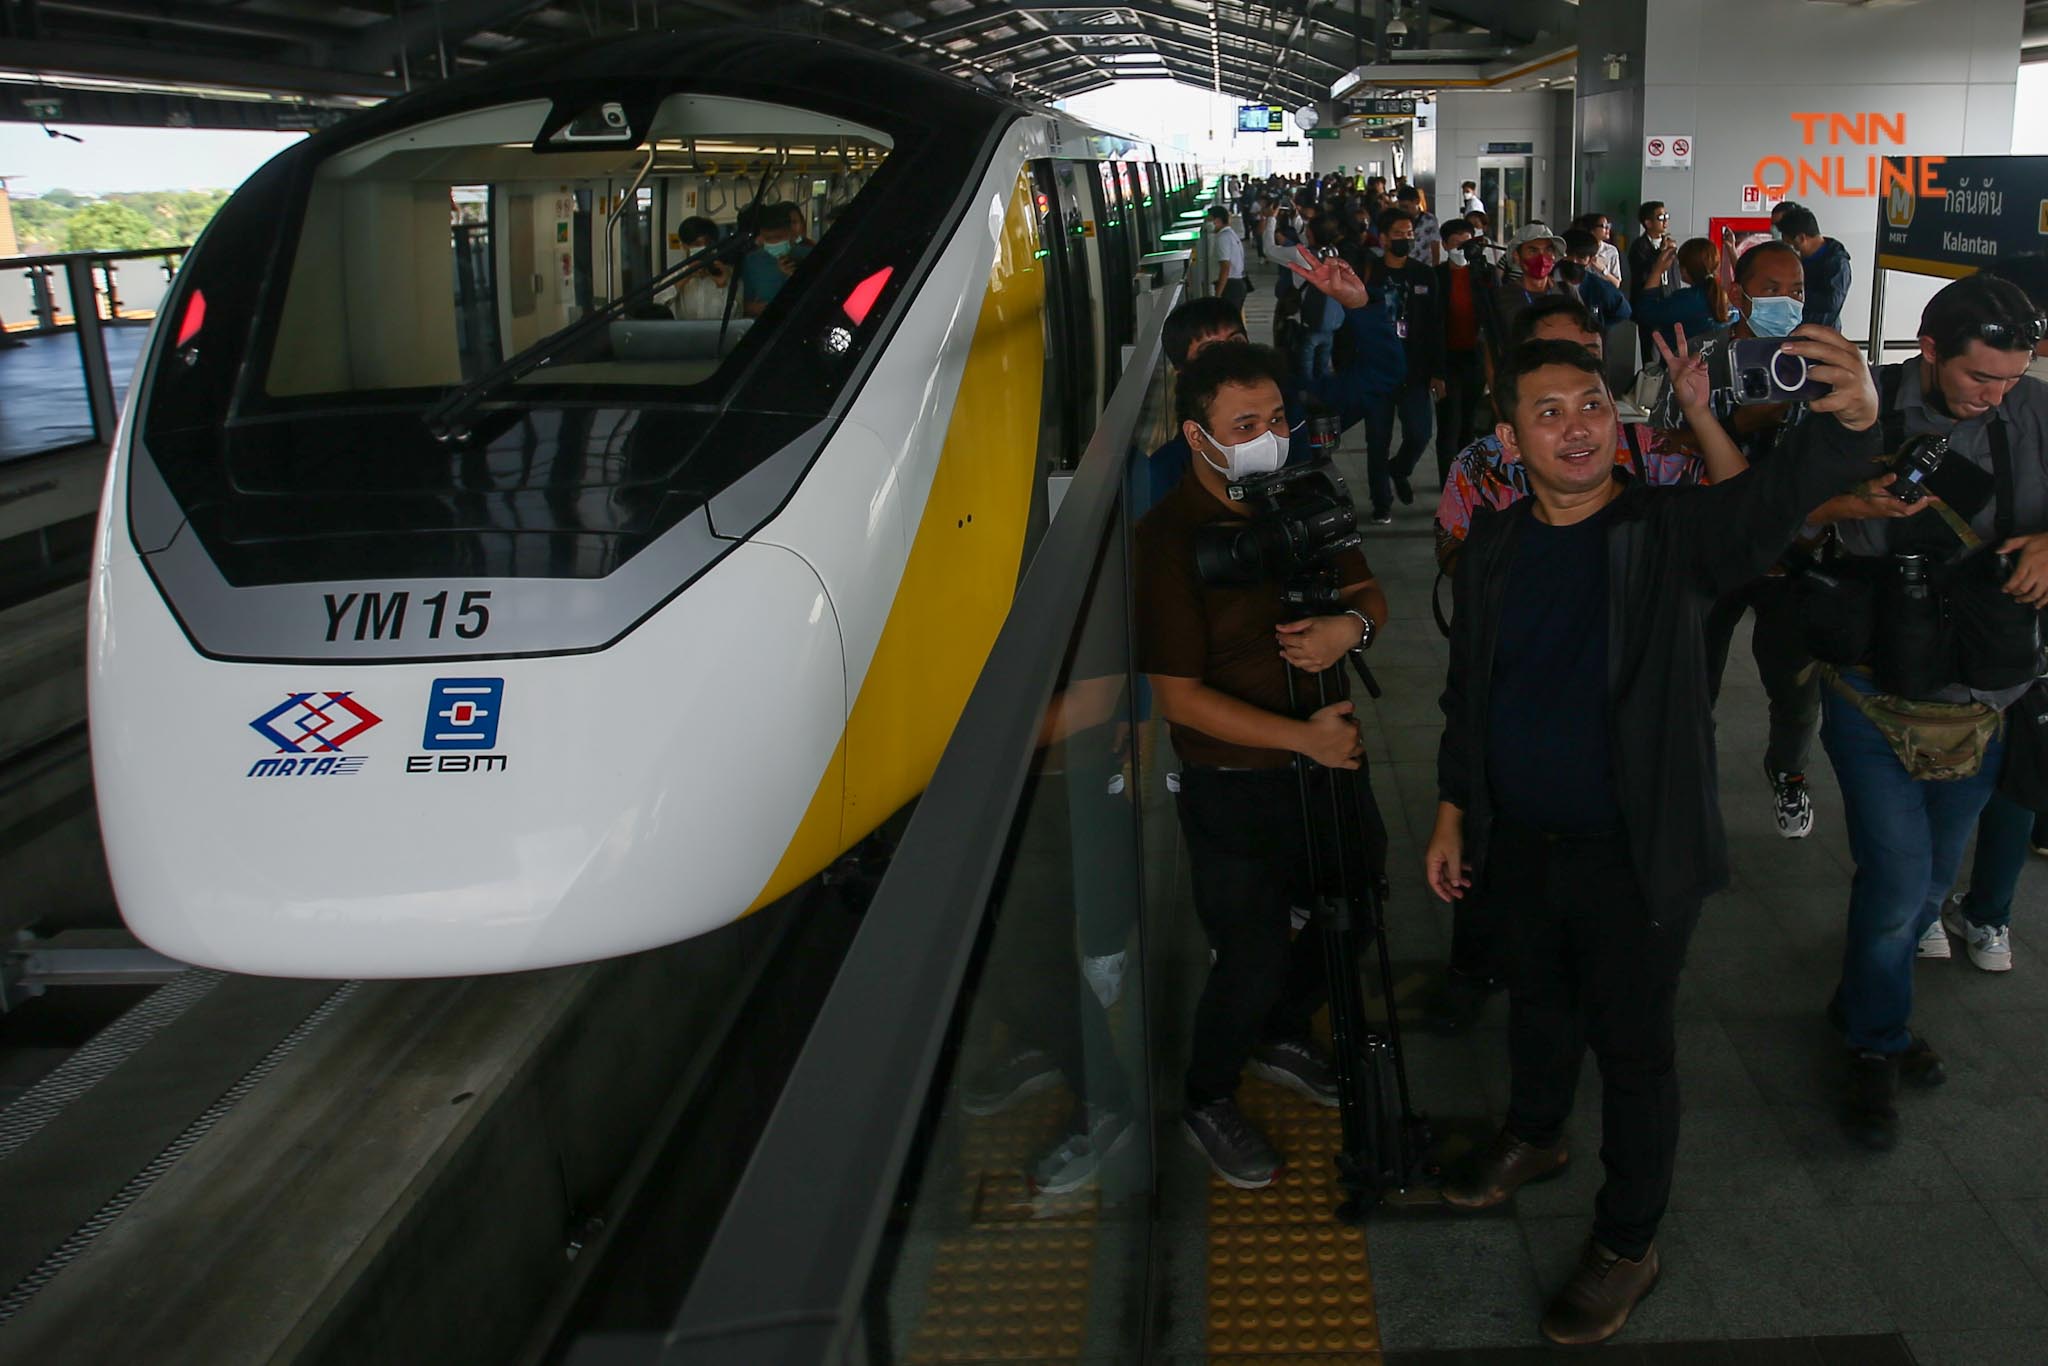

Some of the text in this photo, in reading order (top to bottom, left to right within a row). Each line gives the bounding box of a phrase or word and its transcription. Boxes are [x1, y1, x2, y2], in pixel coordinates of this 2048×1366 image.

[1891, 187, 1910, 220] M
[1944, 177, 2003, 216] กลันตัน
[1888, 232, 1909, 244] MRT
[1943, 231, 1998, 256] Kalantan
[323, 590, 492, 642] YM 15
[247, 756, 350, 778] MRTA
[406, 755, 508, 773] EBM
